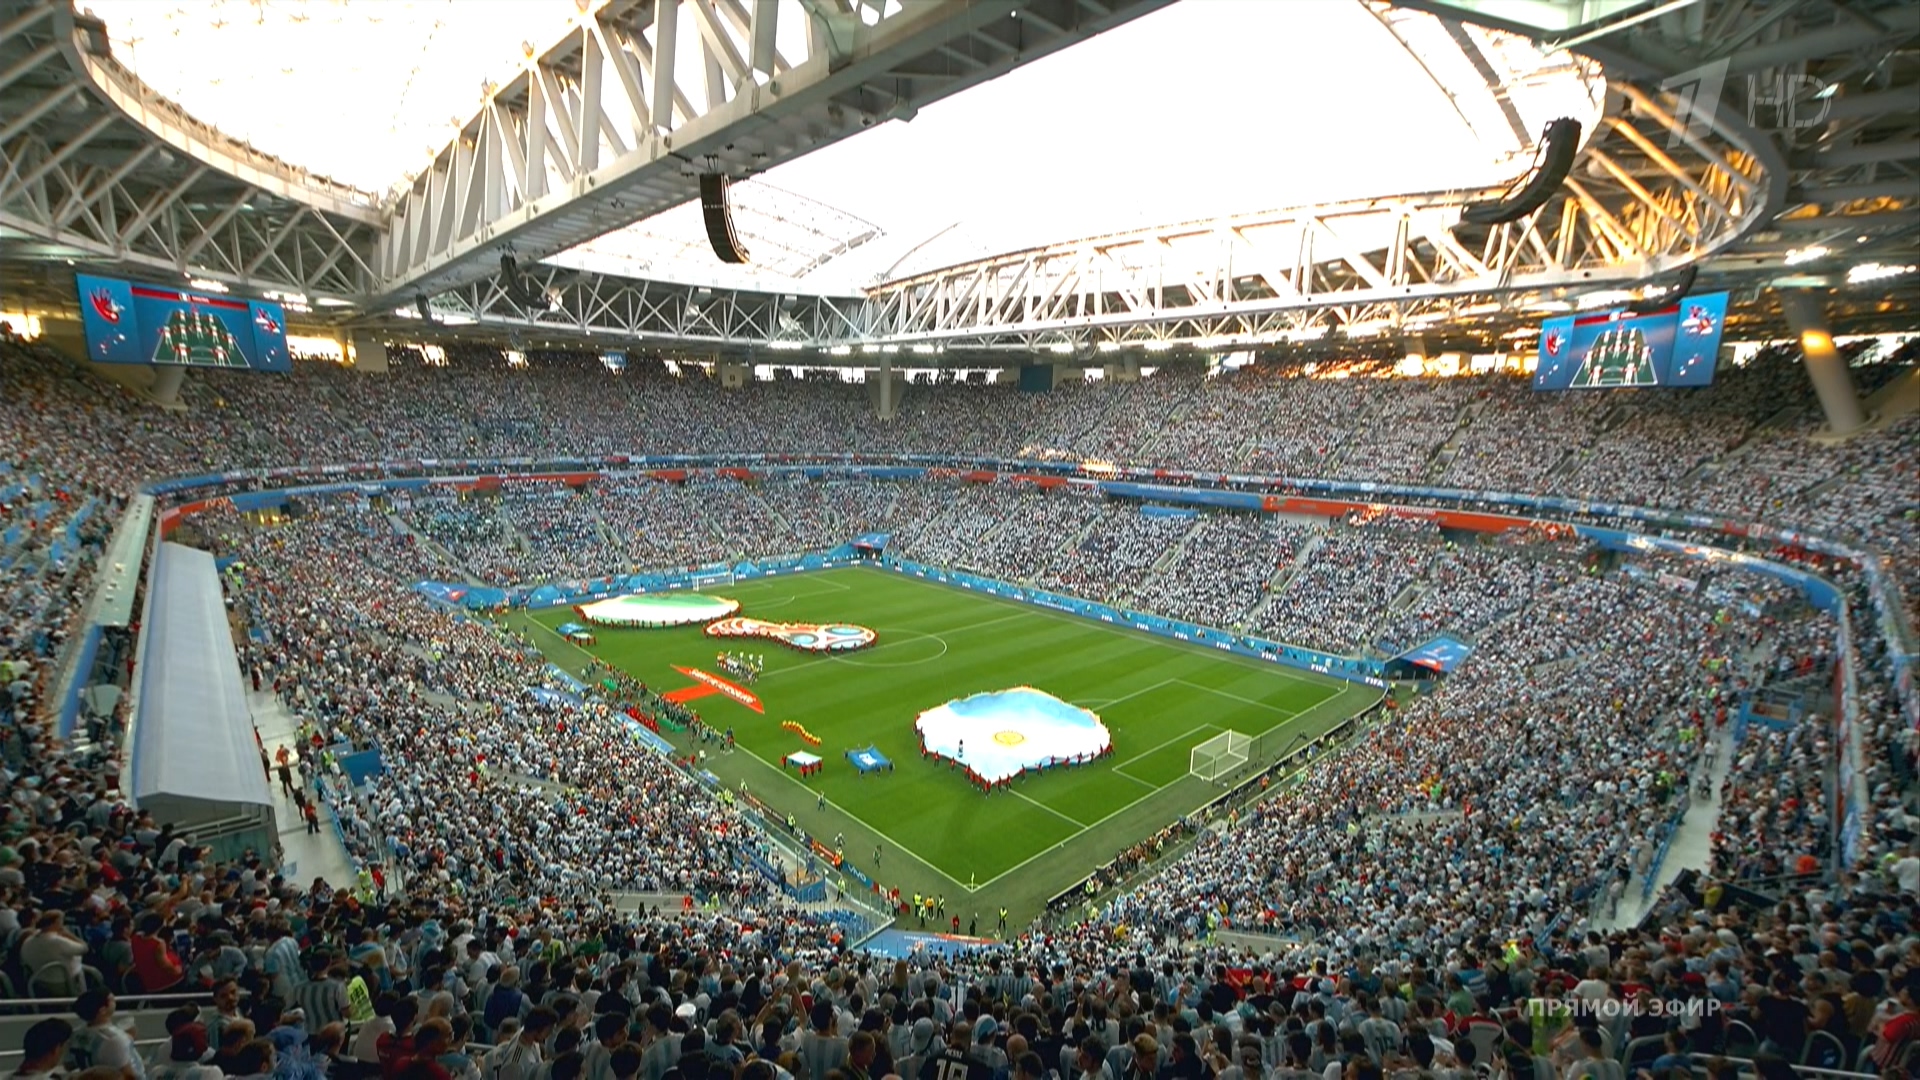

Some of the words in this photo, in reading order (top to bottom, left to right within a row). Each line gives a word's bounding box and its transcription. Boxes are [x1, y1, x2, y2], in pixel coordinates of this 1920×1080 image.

[1216, 641, 1230, 651] FIFA
[1311, 663, 1328, 674] FIFA
[1365, 676, 1384, 687] FIFA
